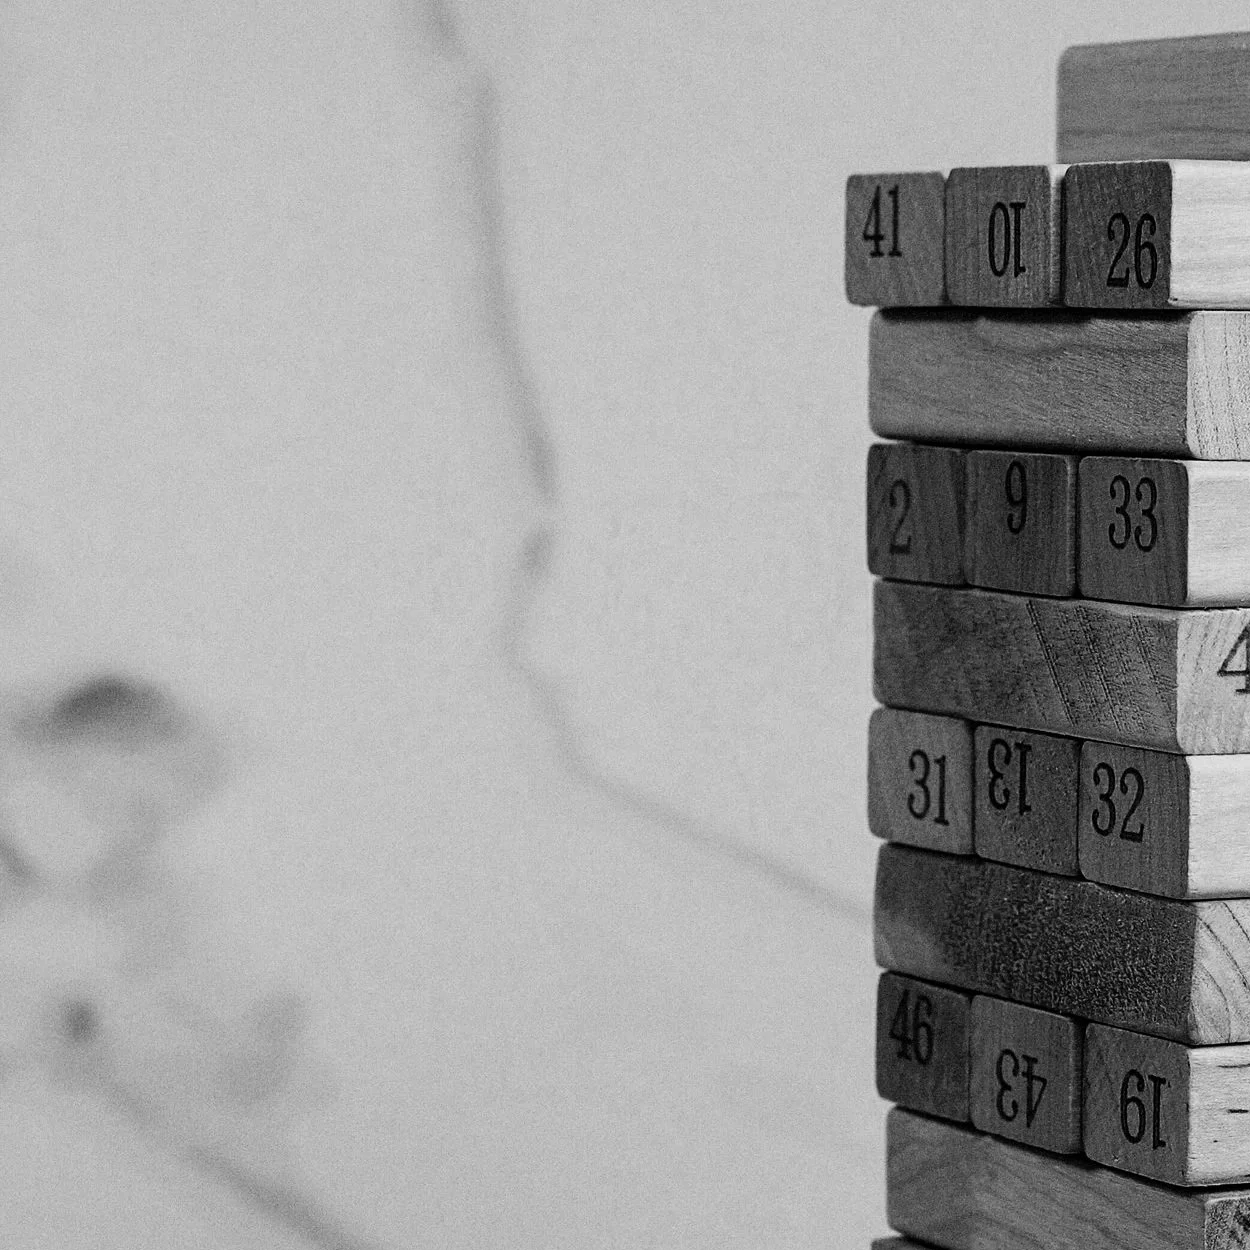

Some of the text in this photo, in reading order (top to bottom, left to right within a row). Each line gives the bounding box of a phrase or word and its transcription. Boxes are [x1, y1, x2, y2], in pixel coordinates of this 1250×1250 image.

[861, 184, 904, 259] 41
[986, 200, 1028, 278] 10
[1105, 212, 1158, 289] 26
[889, 478, 912, 556] 2
[1003, 459, 1029, 535] 9
[1107, 475, 1158, 553] 33
[906, 749, 950, 827] 31
[986, 739, 1033, 816] 13
[1090, 763, 1146, 842] 32
[889, 994, 934, 1066] 46
[996, 1049, 1047, 1127] 43
[1118, 1068, 1169, 1151] 19
